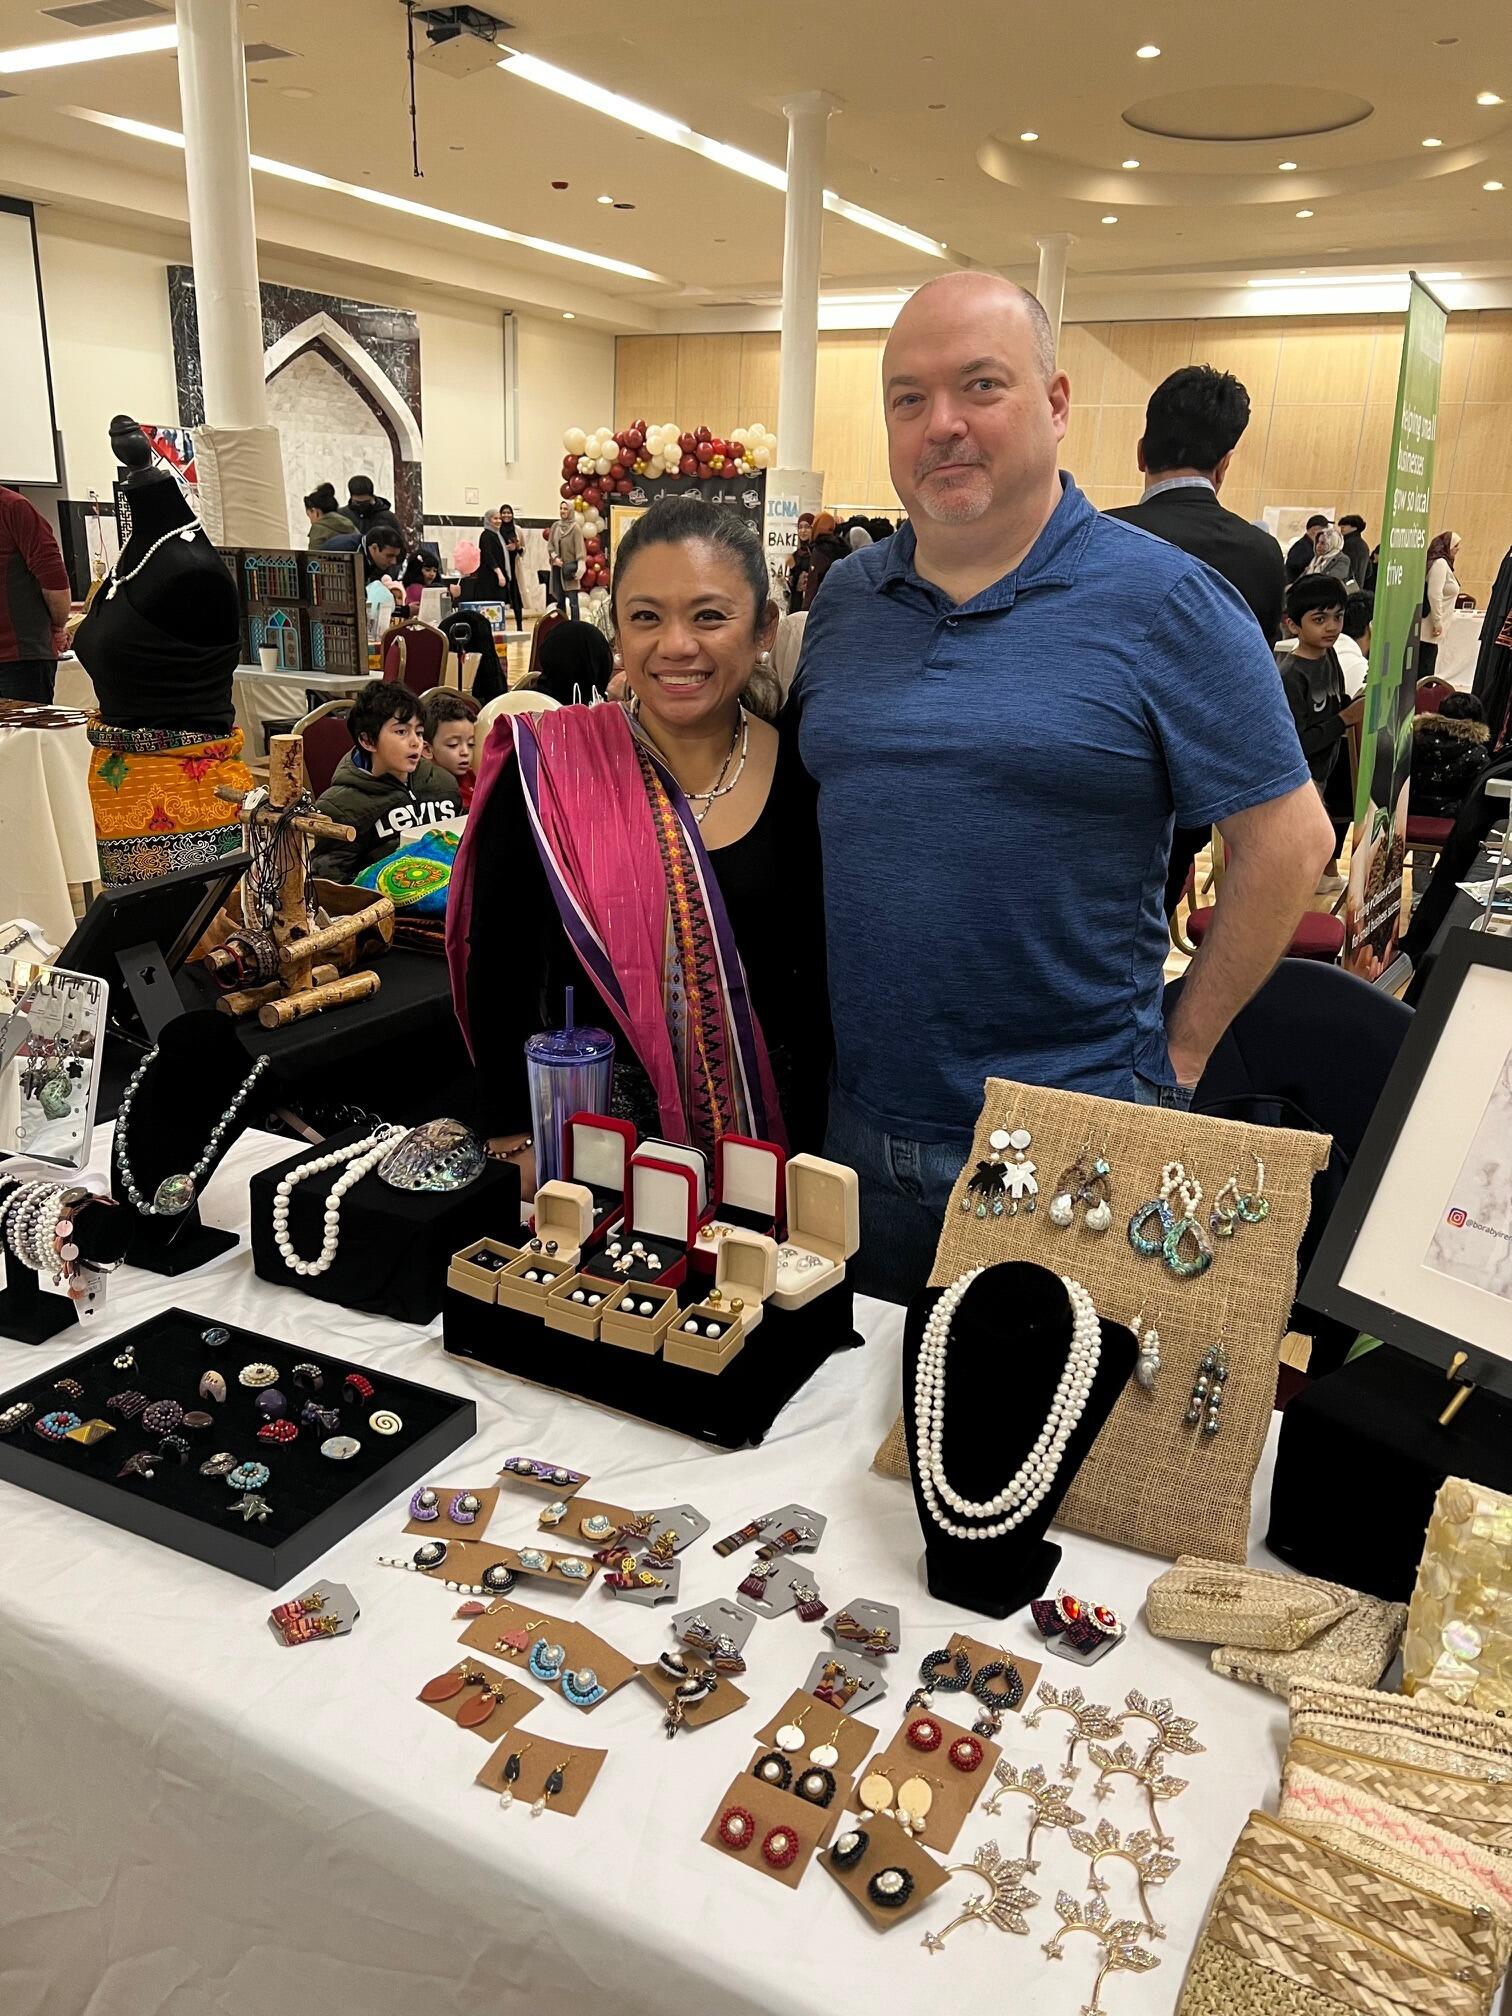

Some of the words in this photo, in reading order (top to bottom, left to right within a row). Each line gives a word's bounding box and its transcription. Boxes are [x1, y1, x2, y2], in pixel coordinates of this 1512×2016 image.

[767, 500, 799, 517] ICNA
[1393, 488, 1407, 516] gow
[1407, 489, 1414, 511] so
[1414, 485, 1429, 513] local
[768, 531, 799, 547] BAKE
[1390, 522, 1426, 548] cmmunities
[1386, 558, 1403, 587] trive
